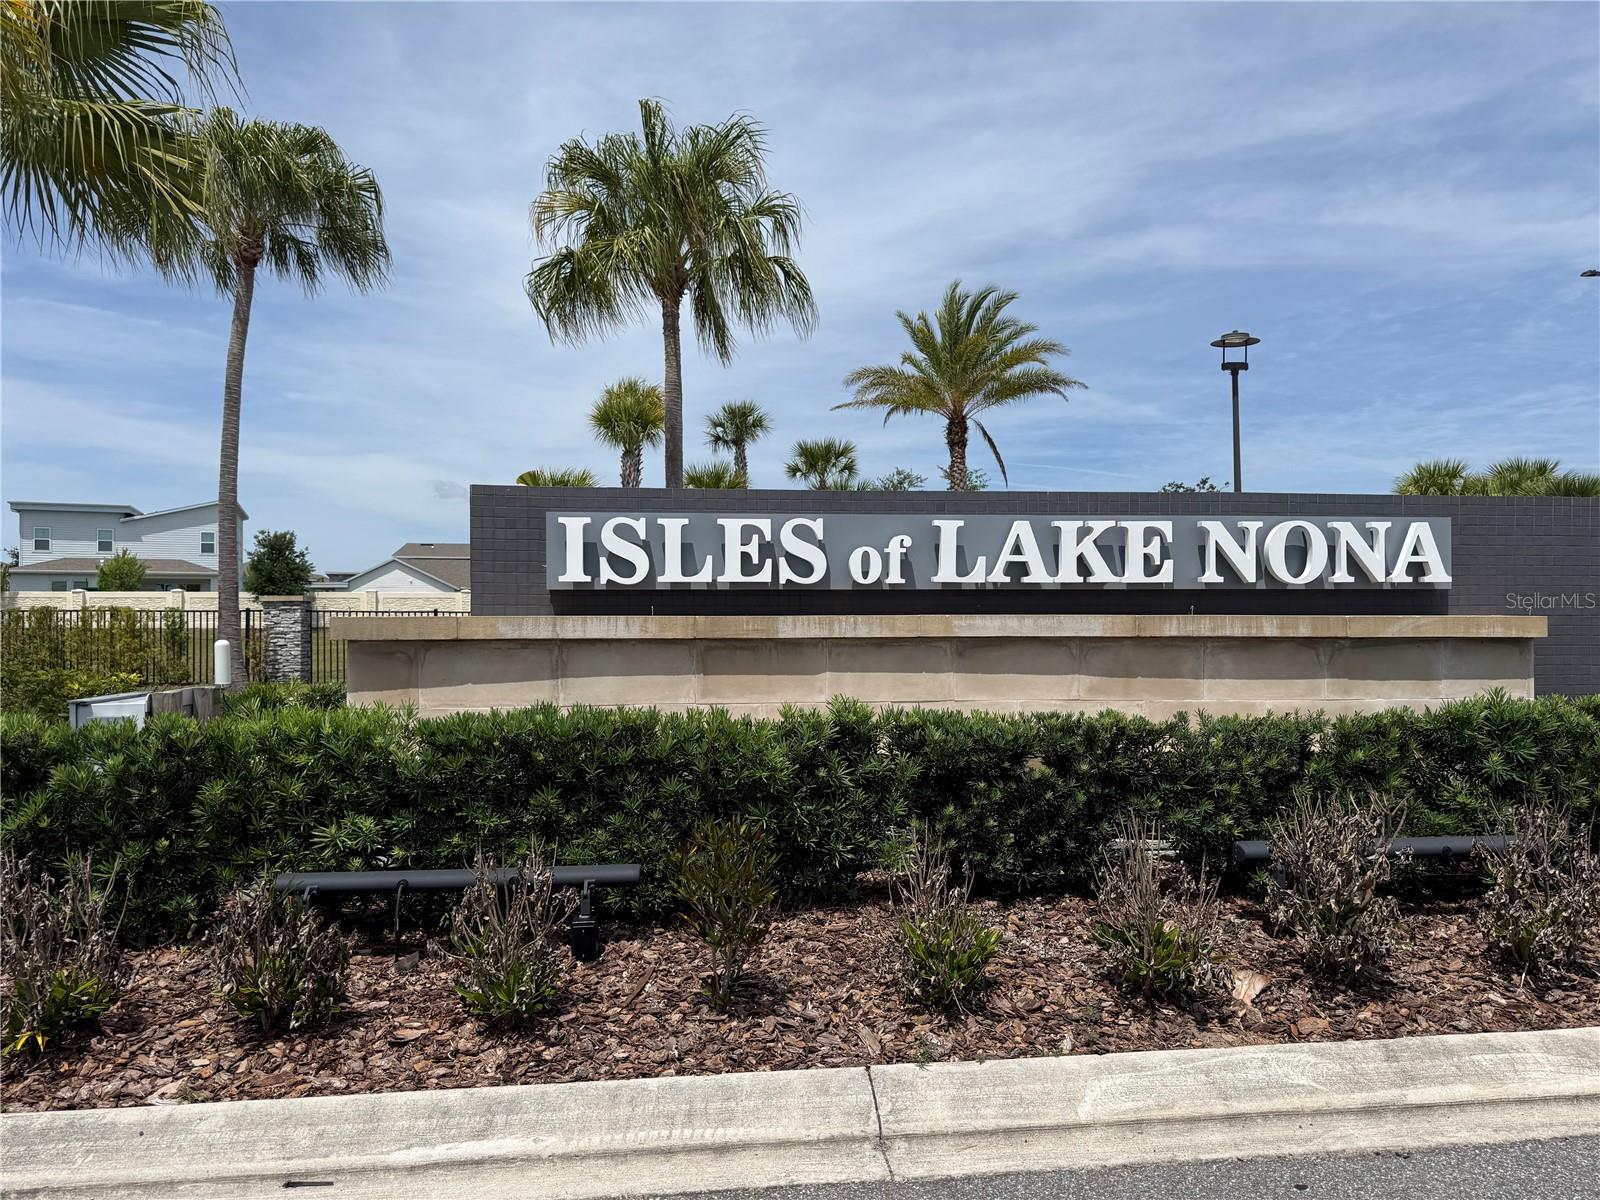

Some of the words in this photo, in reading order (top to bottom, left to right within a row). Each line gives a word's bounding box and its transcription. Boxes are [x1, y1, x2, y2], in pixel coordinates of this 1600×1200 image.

[557, 516, 828, 586] ISLES
[848, 534, 913, 585] of
[930, 518, 1175, 585] LAKE
[1197, 519, 1453, 586] NONA
